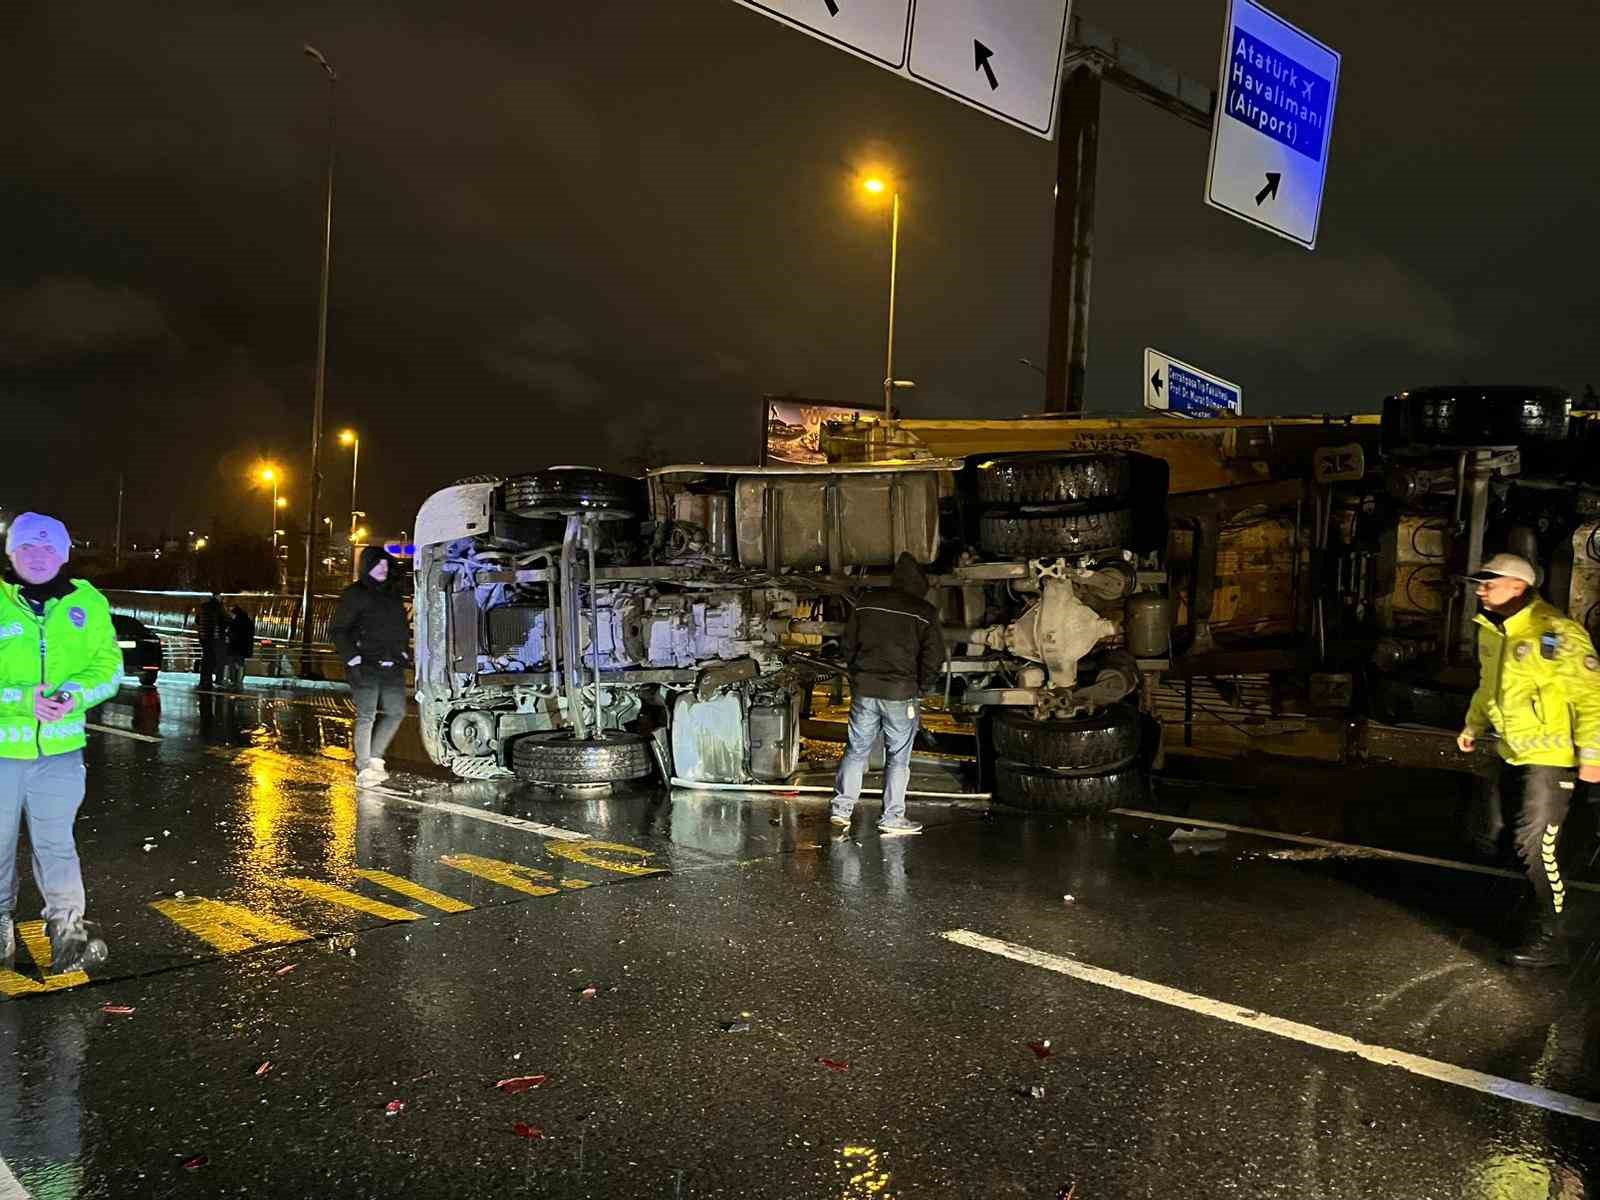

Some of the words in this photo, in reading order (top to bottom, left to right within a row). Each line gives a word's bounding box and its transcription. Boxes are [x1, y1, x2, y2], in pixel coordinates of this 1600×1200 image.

[1235, 37, 1298, 89] Atatürk
[1229, 89, 1298, 145] (Airport)
[1232, 62, 1323, 129] Havalimanı
